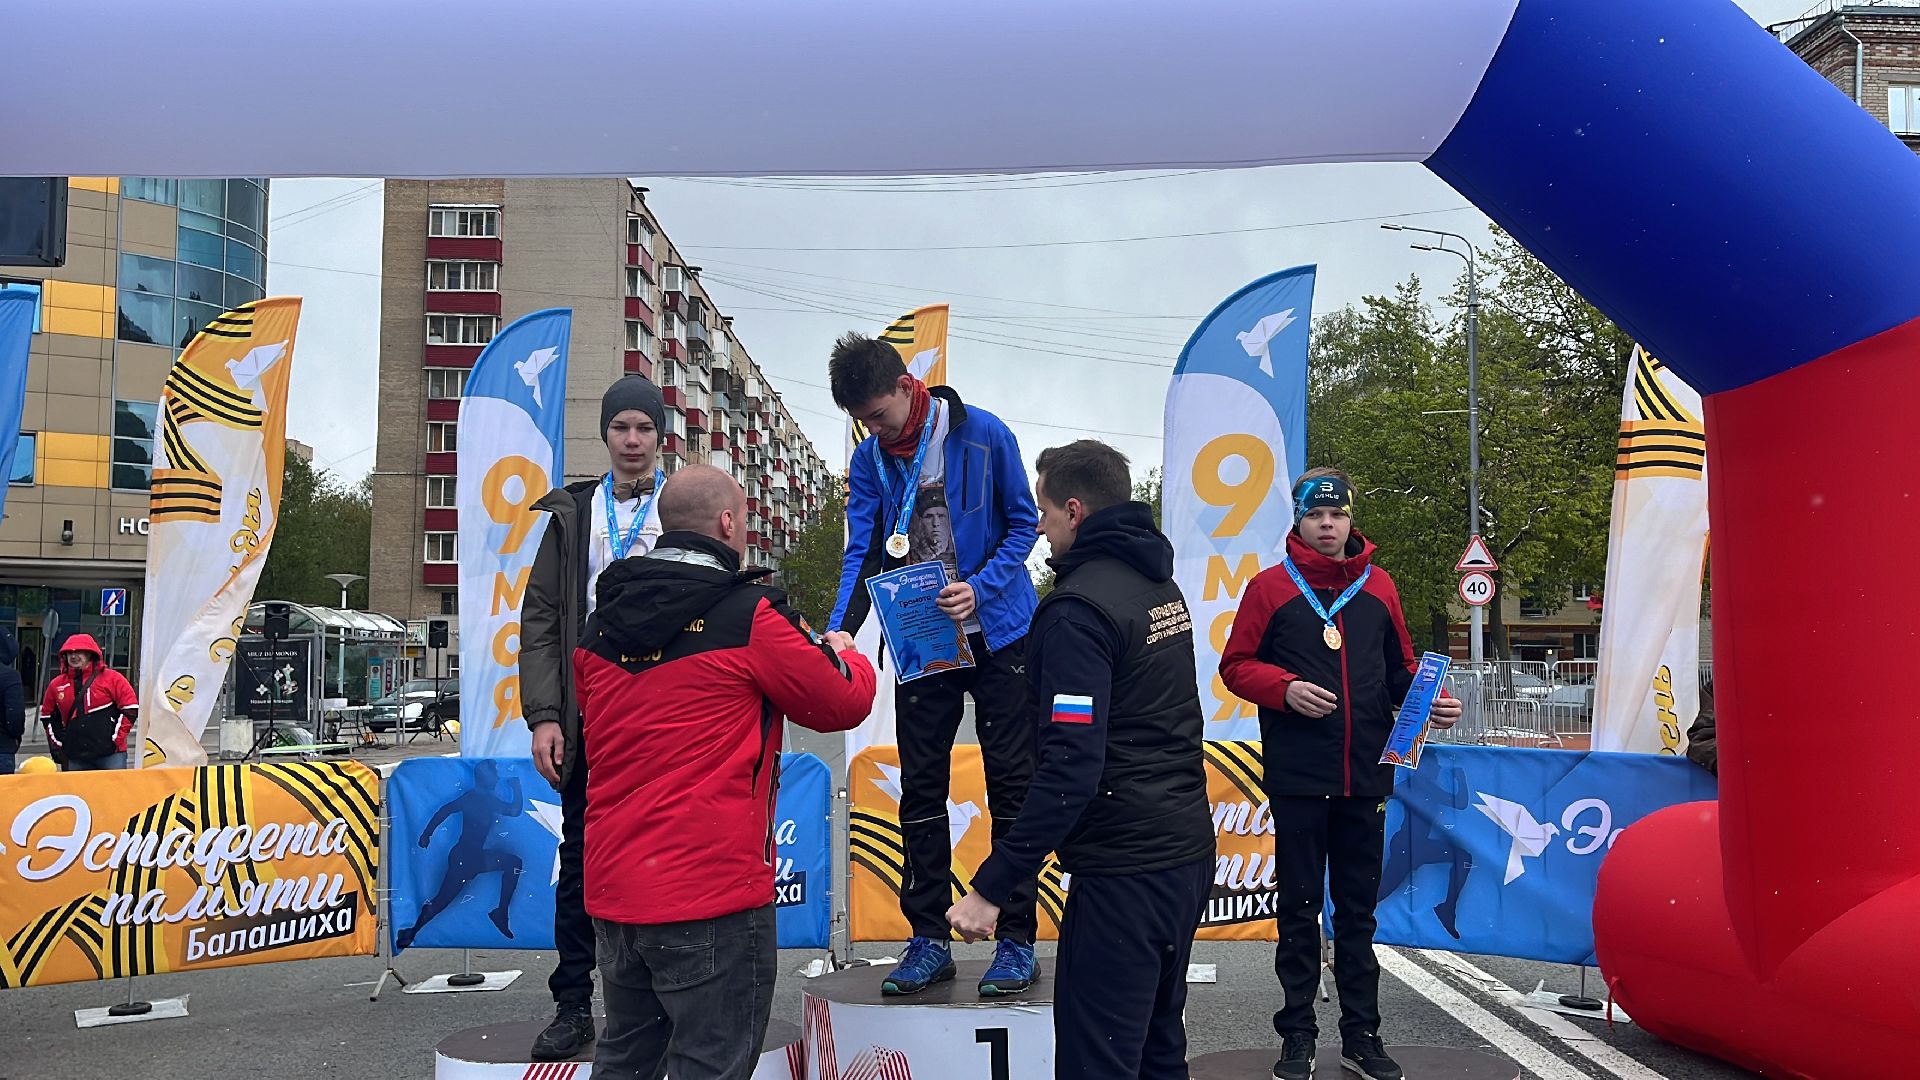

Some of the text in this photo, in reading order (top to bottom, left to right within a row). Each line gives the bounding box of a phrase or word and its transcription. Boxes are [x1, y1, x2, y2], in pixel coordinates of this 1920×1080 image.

[482, 455, 548, 554] 9
[1192, 433, 1275, 538] 9
[899, 595, 932, 608] Грамота
[1467, 582, 1487, 595] 40
[1653, 665, 1680, 755] ень
[11, 795, 350, 883] Эстафета
[100, 872, 346, 927] памяти
[187, 907, 352, 962] Балашиха
[975, 1028, 1009, 1080] 1
